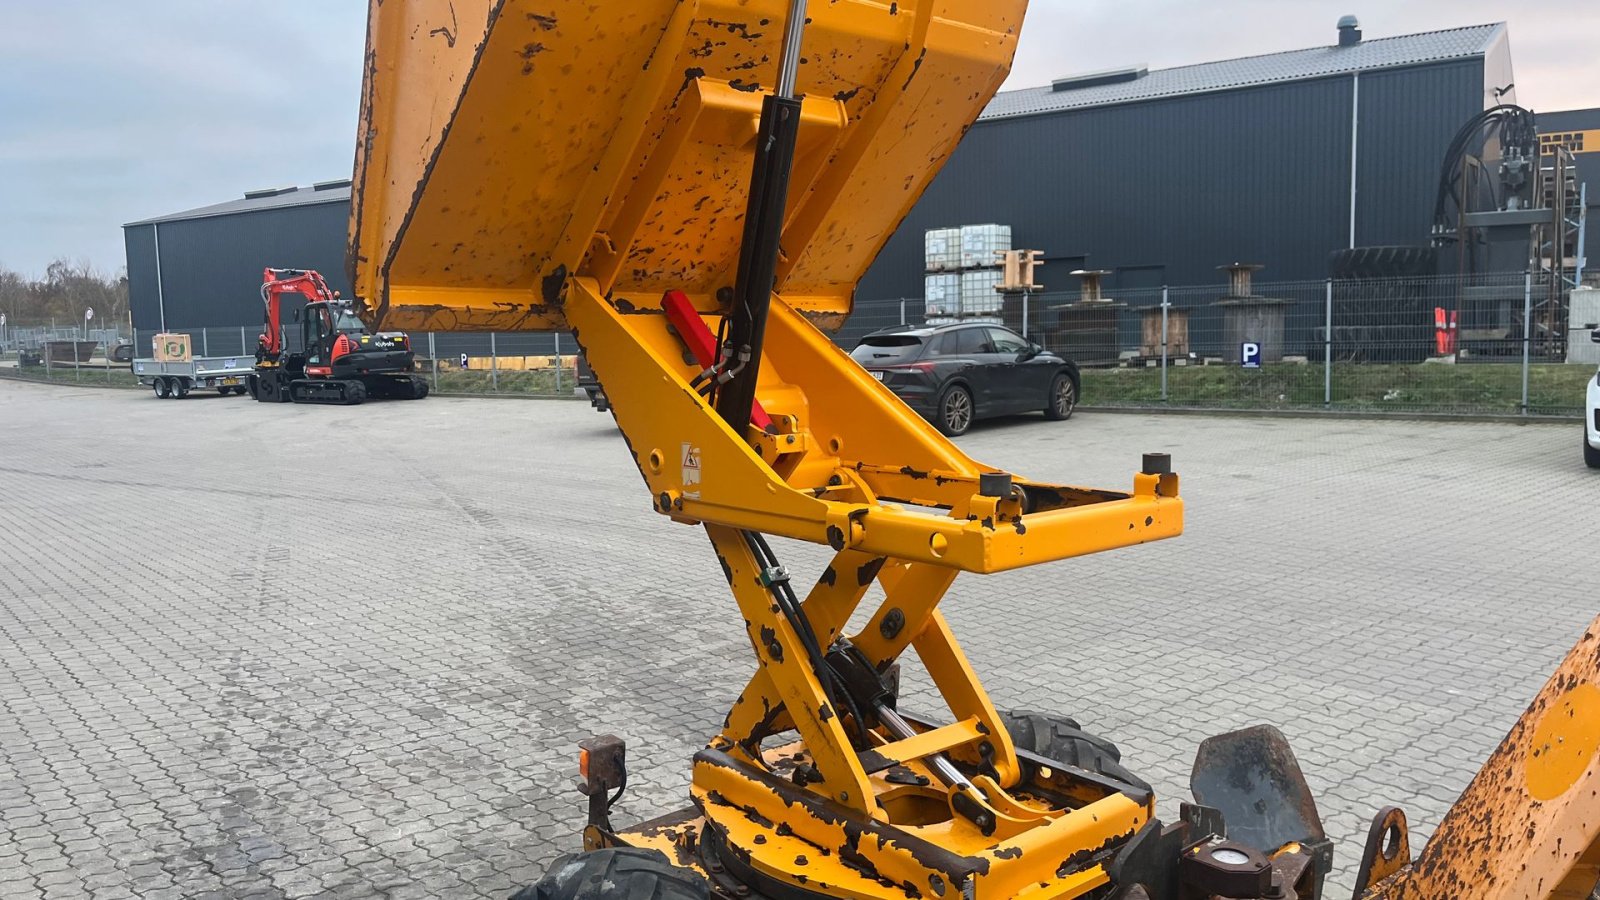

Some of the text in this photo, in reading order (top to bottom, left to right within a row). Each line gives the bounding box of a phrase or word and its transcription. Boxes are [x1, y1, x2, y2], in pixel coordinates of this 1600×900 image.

[1537, 133, 1583, 154] MM
[461, 353, 468, 365] P
[1243, 343, 1259, 362] P
